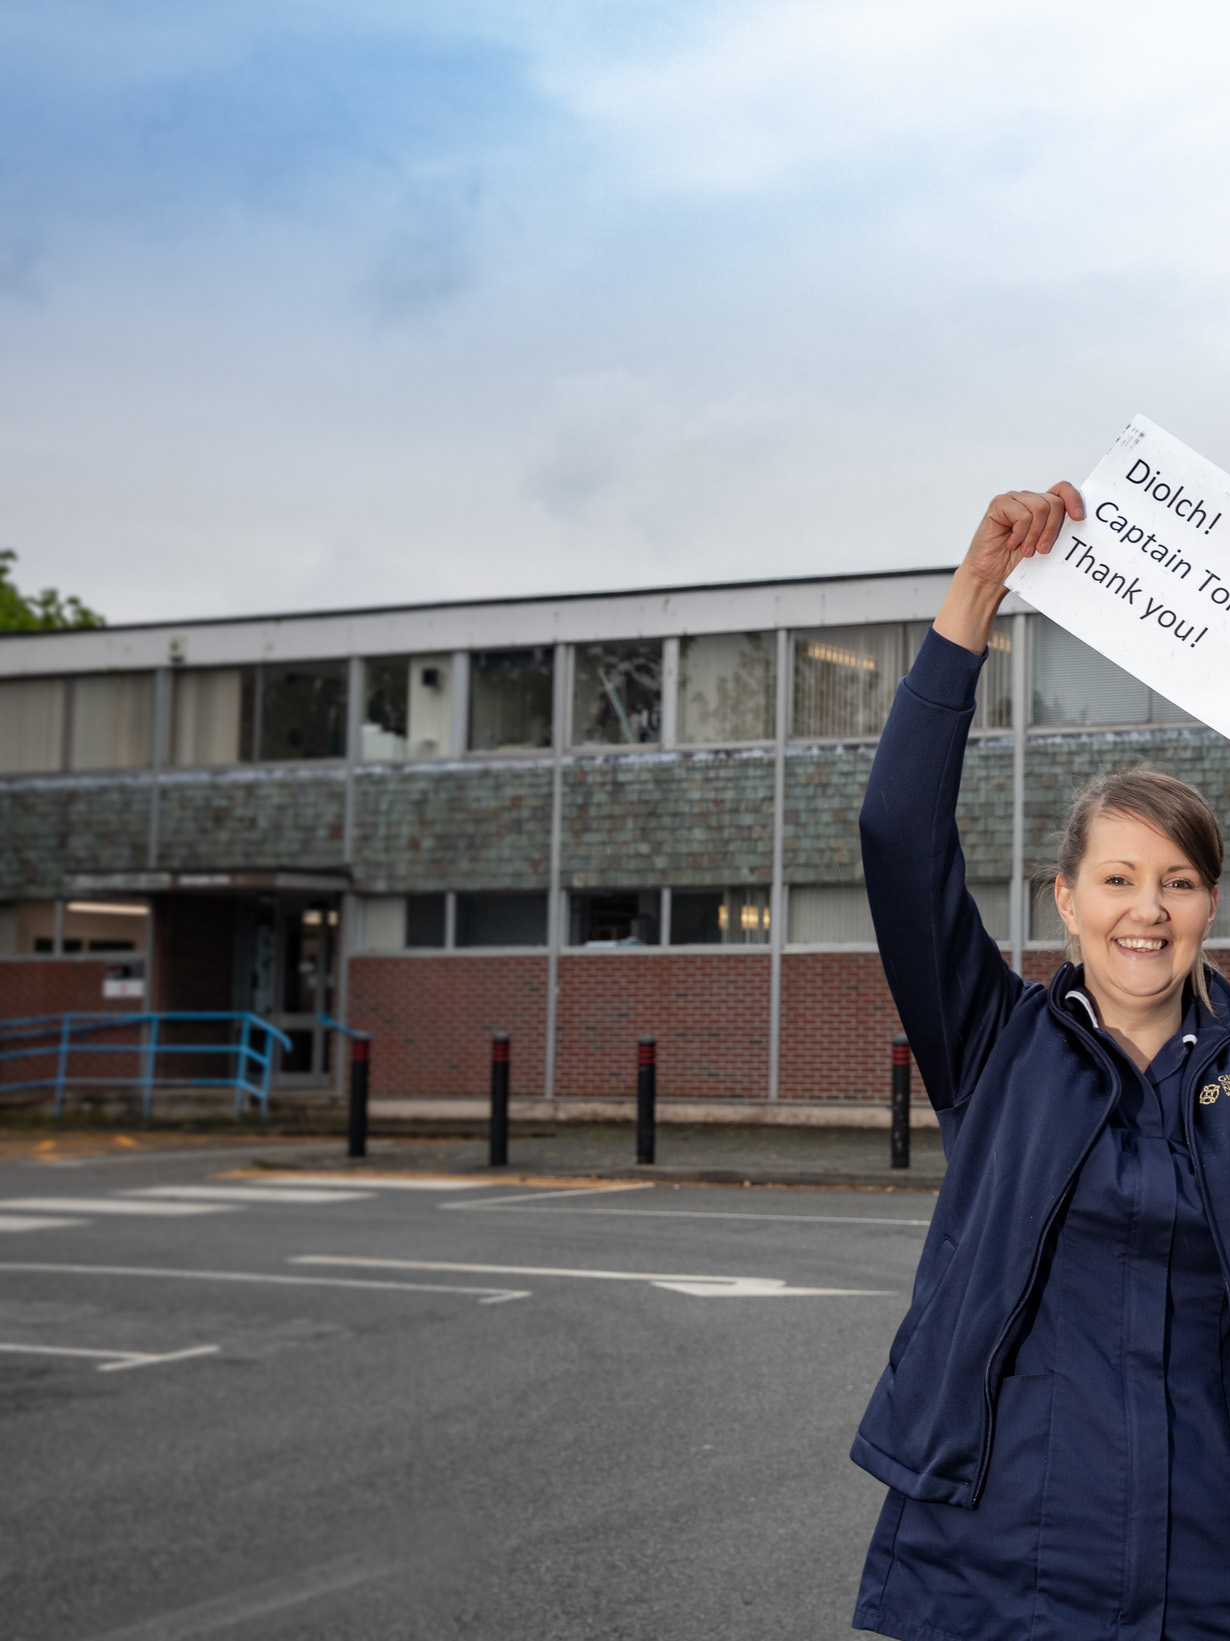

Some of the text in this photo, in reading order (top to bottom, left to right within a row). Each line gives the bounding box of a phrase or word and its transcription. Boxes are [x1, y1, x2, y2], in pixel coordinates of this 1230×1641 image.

[1126, 458, 1222, 535] Diolch!
[1095, 501, 1192, 579] Captain
[1064, 536, 1209, 648] Thank you!
